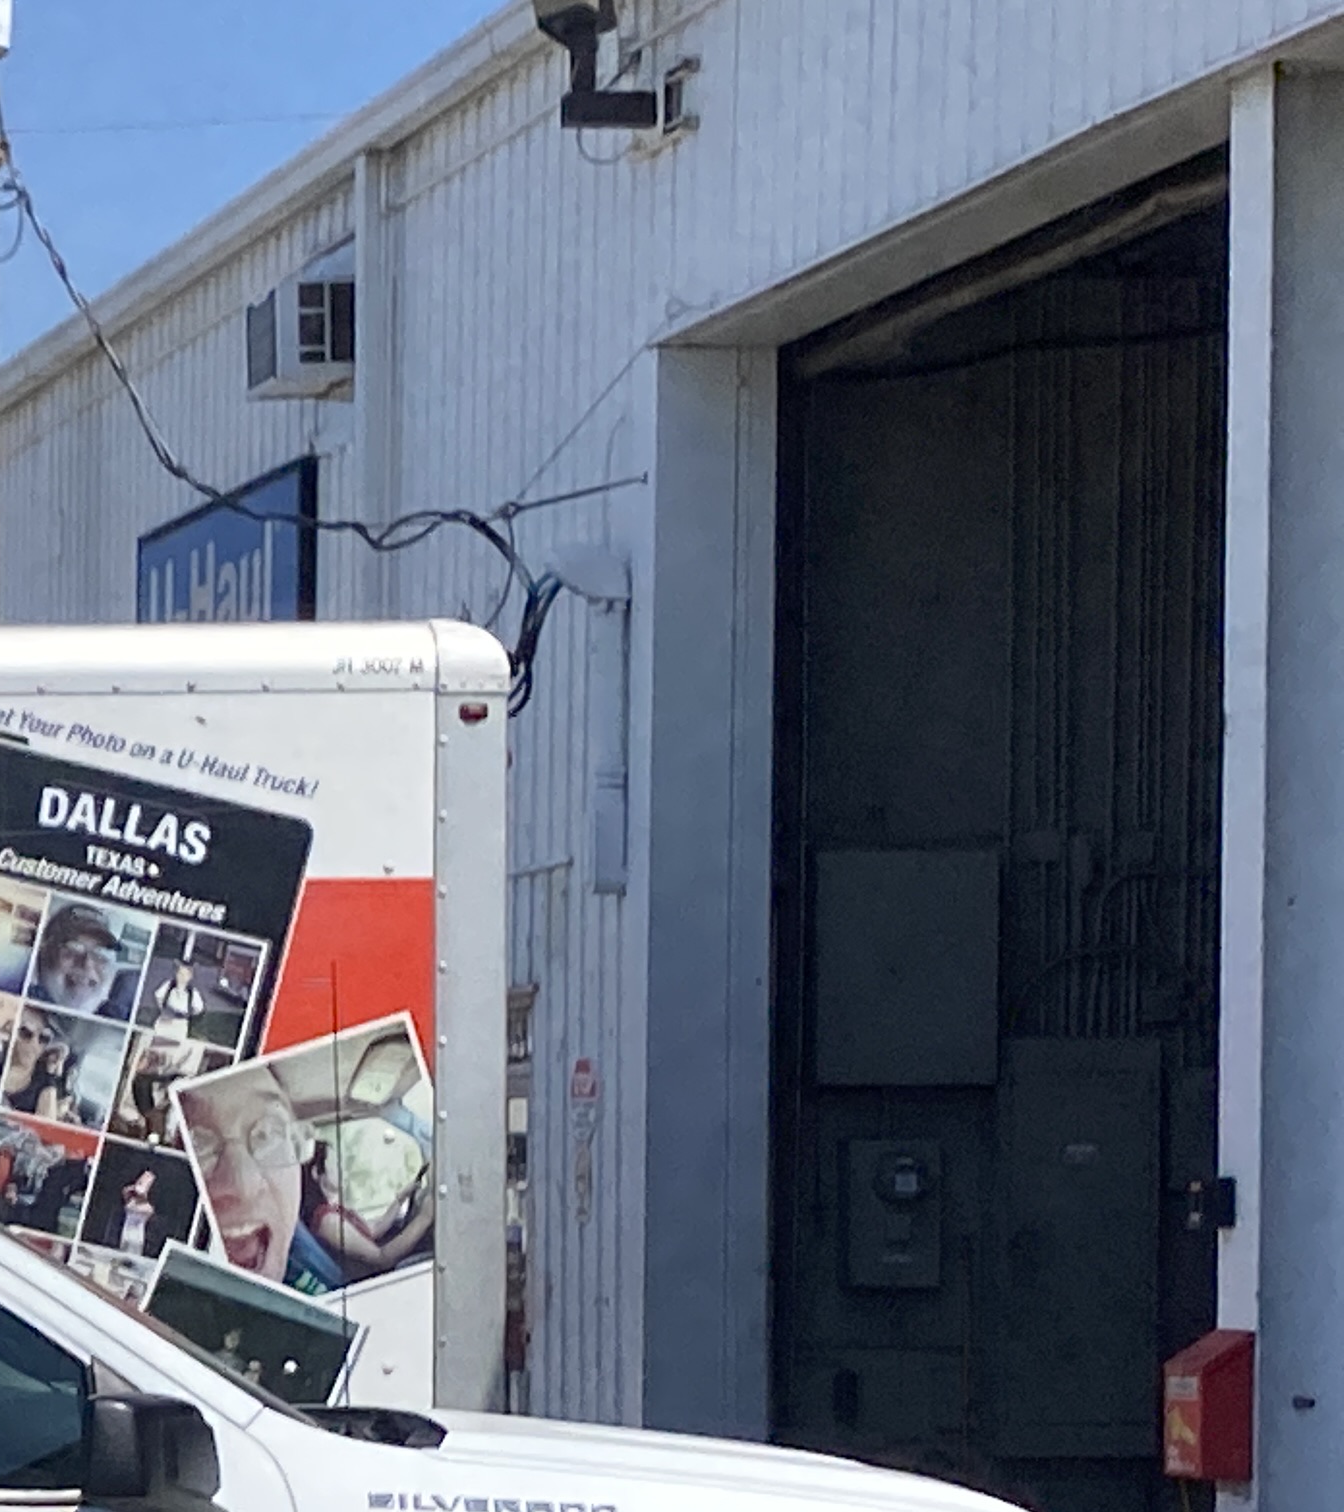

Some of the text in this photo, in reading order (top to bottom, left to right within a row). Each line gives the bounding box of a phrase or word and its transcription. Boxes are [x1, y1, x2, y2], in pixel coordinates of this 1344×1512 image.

[19, 708, 65, 738] Your
[66, 722, 126, 752] Photo
[129, 740, 157, 761] on
[160, 751, 173, 765] a
[177, 748, 249, 783] U-Haul
[252, 764, 320, 799] Truck!
[37, 786, 211, 865] DALLAS
[86, 844, 146, 877] TEXAS
[101, 875, 227, 923] Adventures
